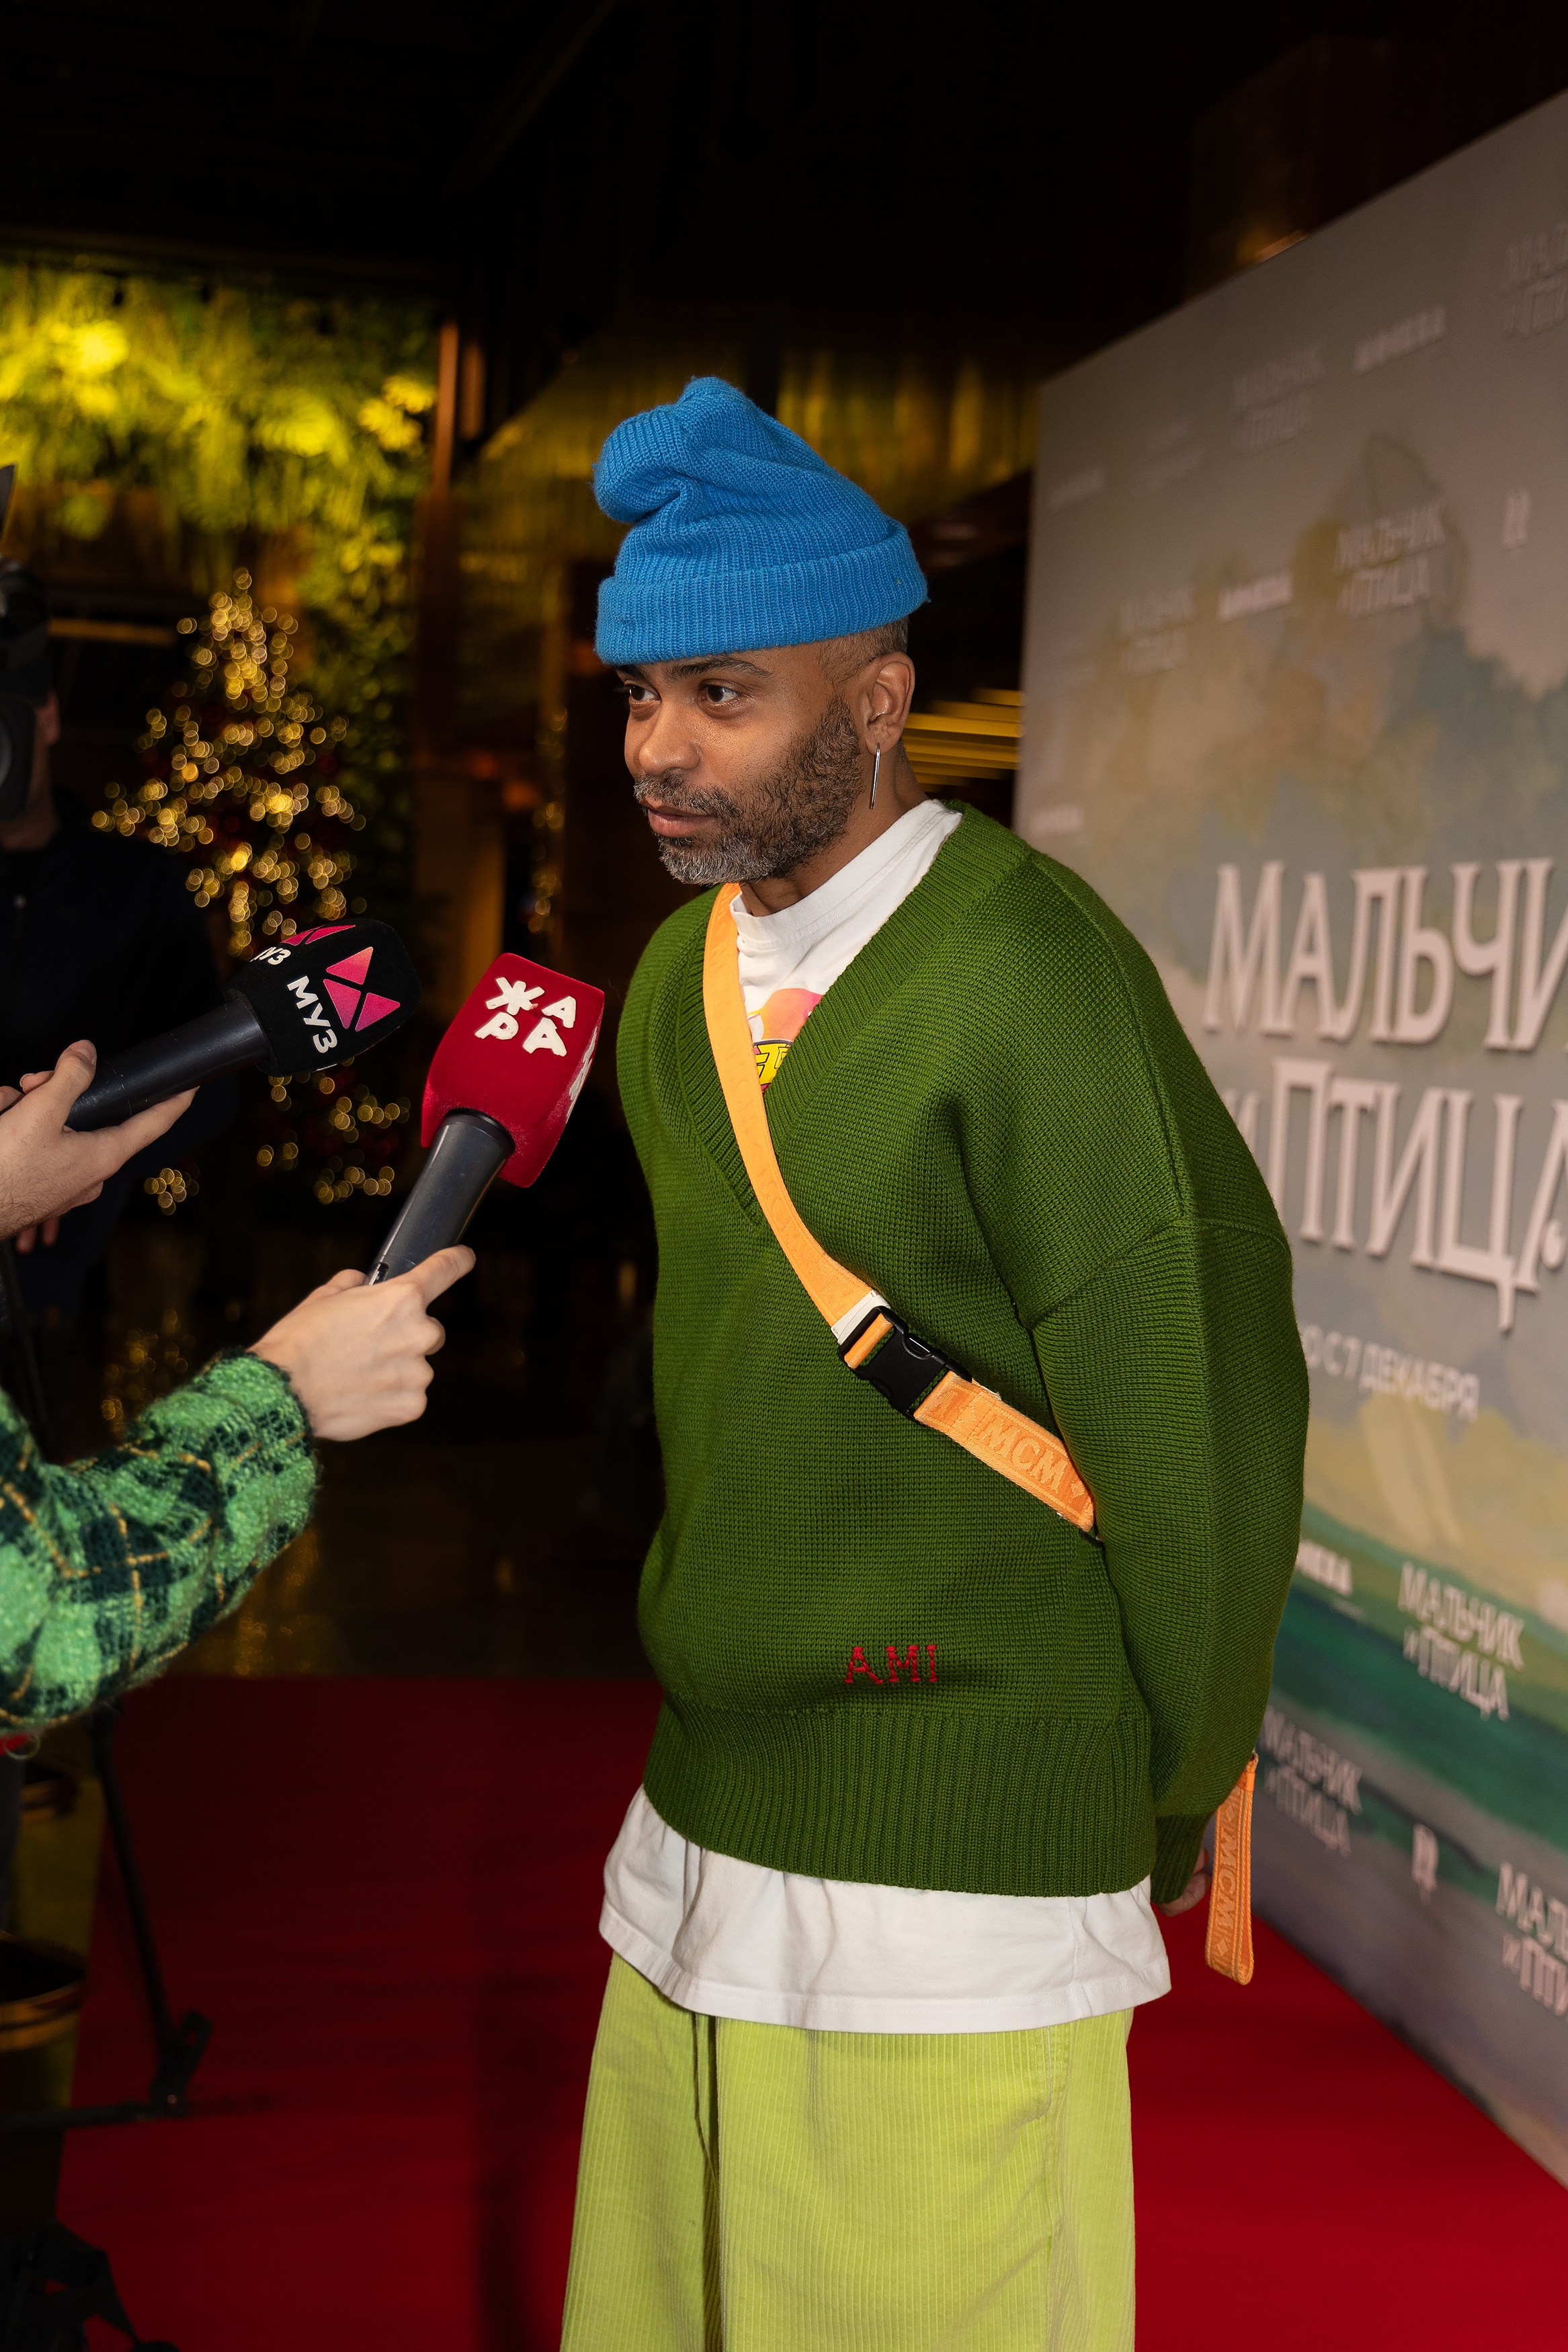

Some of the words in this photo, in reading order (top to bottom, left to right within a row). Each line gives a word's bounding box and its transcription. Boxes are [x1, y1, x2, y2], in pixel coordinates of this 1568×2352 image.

[249, 946, 292, 965] УЗ
[1202, 858, 1568, 1055] МАЛЬЧИ
[286, 975, 338, 1054] МУЗ
[1358, 1342, 1479, 1423] ДЕКАБРЯ
[977, 1414, 1069, 1494] MCM
[1397, 1560, 1525, 1672] МАЛЬЧИК
[843, 1644, 938, 1684] AMI
[1417, 1625, 1510, 1722] ПТИЦА
[1495, 1860, 1568, 1963] МАЛ
